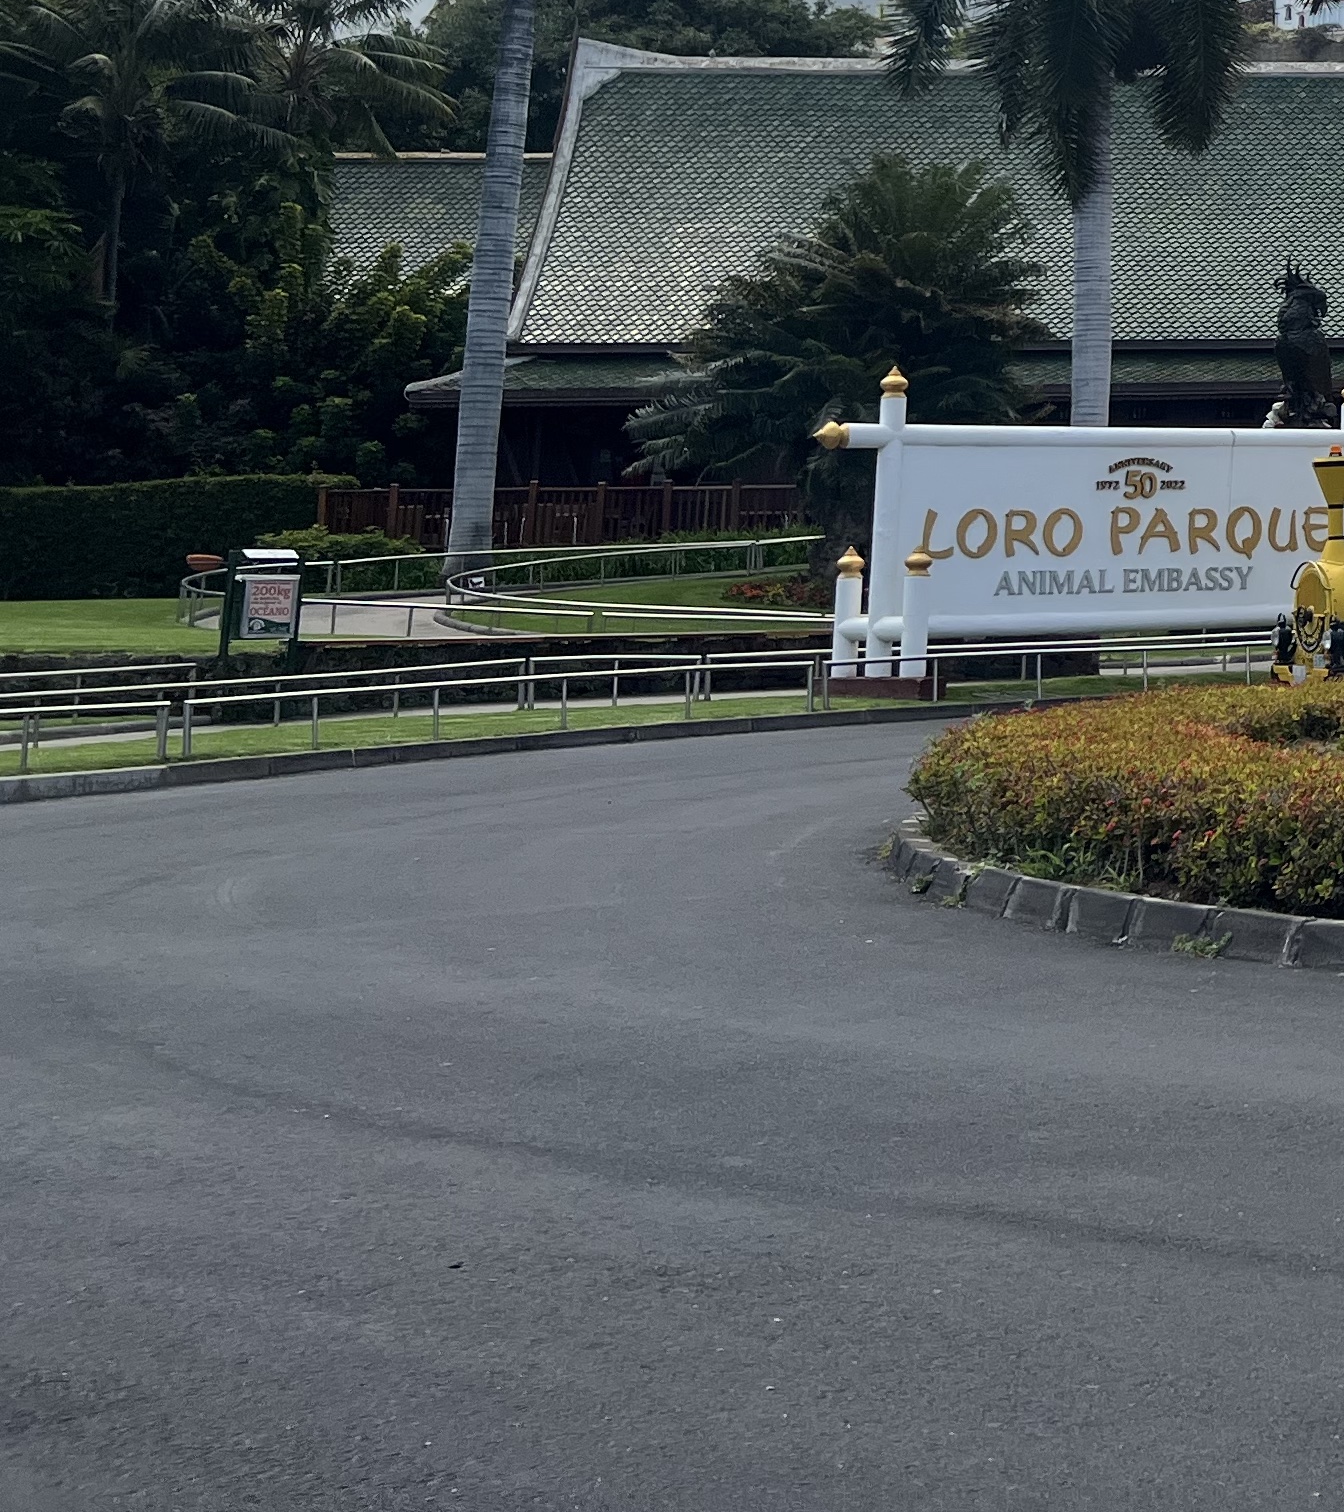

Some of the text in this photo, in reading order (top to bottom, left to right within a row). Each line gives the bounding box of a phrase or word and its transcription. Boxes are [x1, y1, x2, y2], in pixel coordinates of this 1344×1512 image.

[1095, 480, 1120, 491] 1972
[1123, 468, 1158, 500] 50
[1160, 480, 1186, 490] 2022
[922, 505, 1329, 560] LORO PARQUE
[993, 565, 1254, 597] ANIMAL EMBASSY
[252, 586, 290, 599] 200kg
